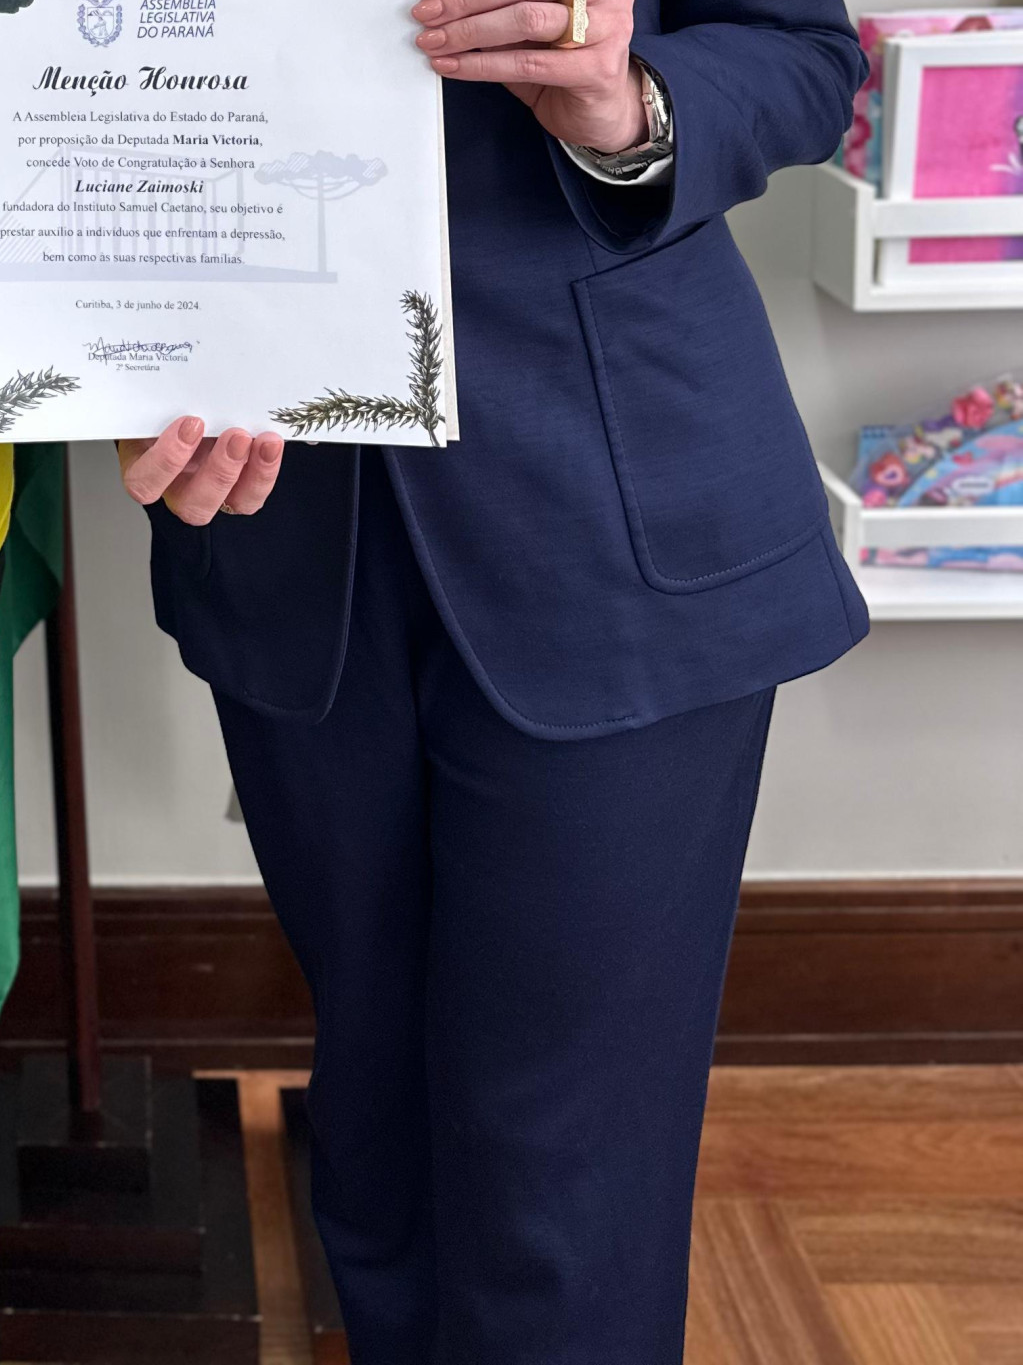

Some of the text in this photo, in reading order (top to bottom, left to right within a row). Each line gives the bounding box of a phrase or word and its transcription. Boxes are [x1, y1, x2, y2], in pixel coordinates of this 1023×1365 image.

[140, 12, 215, 23] LEGISLATIVA
[137, 24, 214, 38] DO PARANÁ
[33, 66, 248, 97] Menção Honrosa
[13, 111, 268, 124] A Assembleia Legislativa do Estado do Paraná,
[18, 134, 262, 147] por proposição da Deputada Maria Victoria,
[26, 157, 254, 170] concede Voto de Congratulação à Senhora
[75, 180, 204, 194] Luciane Zaimoski
[3, 201, 283, 216] fundadora do Instituto Samuel Caetano, seu objetivo é
[0, 228, 35, 239] prestar
[38, 226, 74, 236] auxílio
[77, 229, 83, 237] a
[86, 227, 140, 237] indivíduos
[143, 230, 162, 240] que
[165, 228, 218, 238] enfrentam
[230, 228, 285, 241] depressão,
[43, 251, 64, 261] bem
[100, 252, 110, 263] às
[139, 253, 196, 265] respectivas
[200, 253, 245, 264] famílias.
[75, 300, 201, 311] Curitiba, 3 de junho de 2024.
[88, 353, 188, 362] Deputada Maria Victoria
